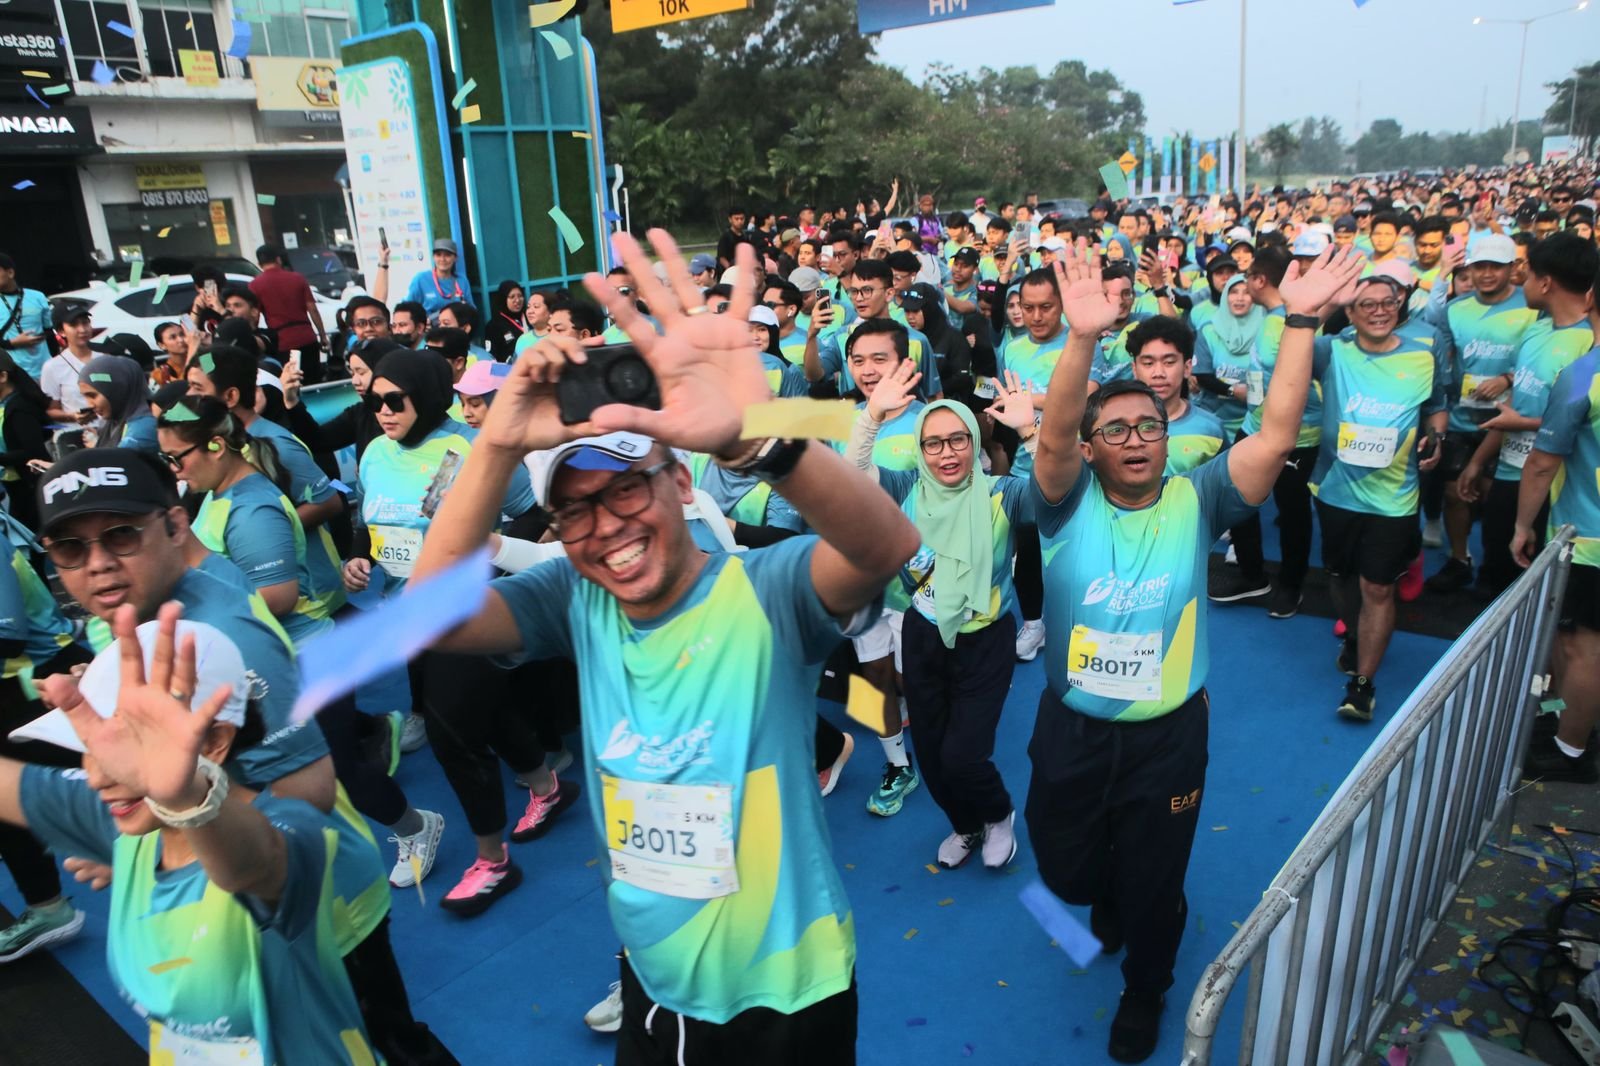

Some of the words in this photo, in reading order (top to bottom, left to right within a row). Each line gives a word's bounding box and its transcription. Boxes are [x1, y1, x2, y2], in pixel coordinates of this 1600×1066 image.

[658, 0, 690, 17] 10K
[43, 466, 129, 505] PING
[376, 546, 411, 562] K6162
[1141, 649, 1155, 657] KM
[1078, 653, 1143, 677] J8017
[617, 819, 697, 857] J8013
